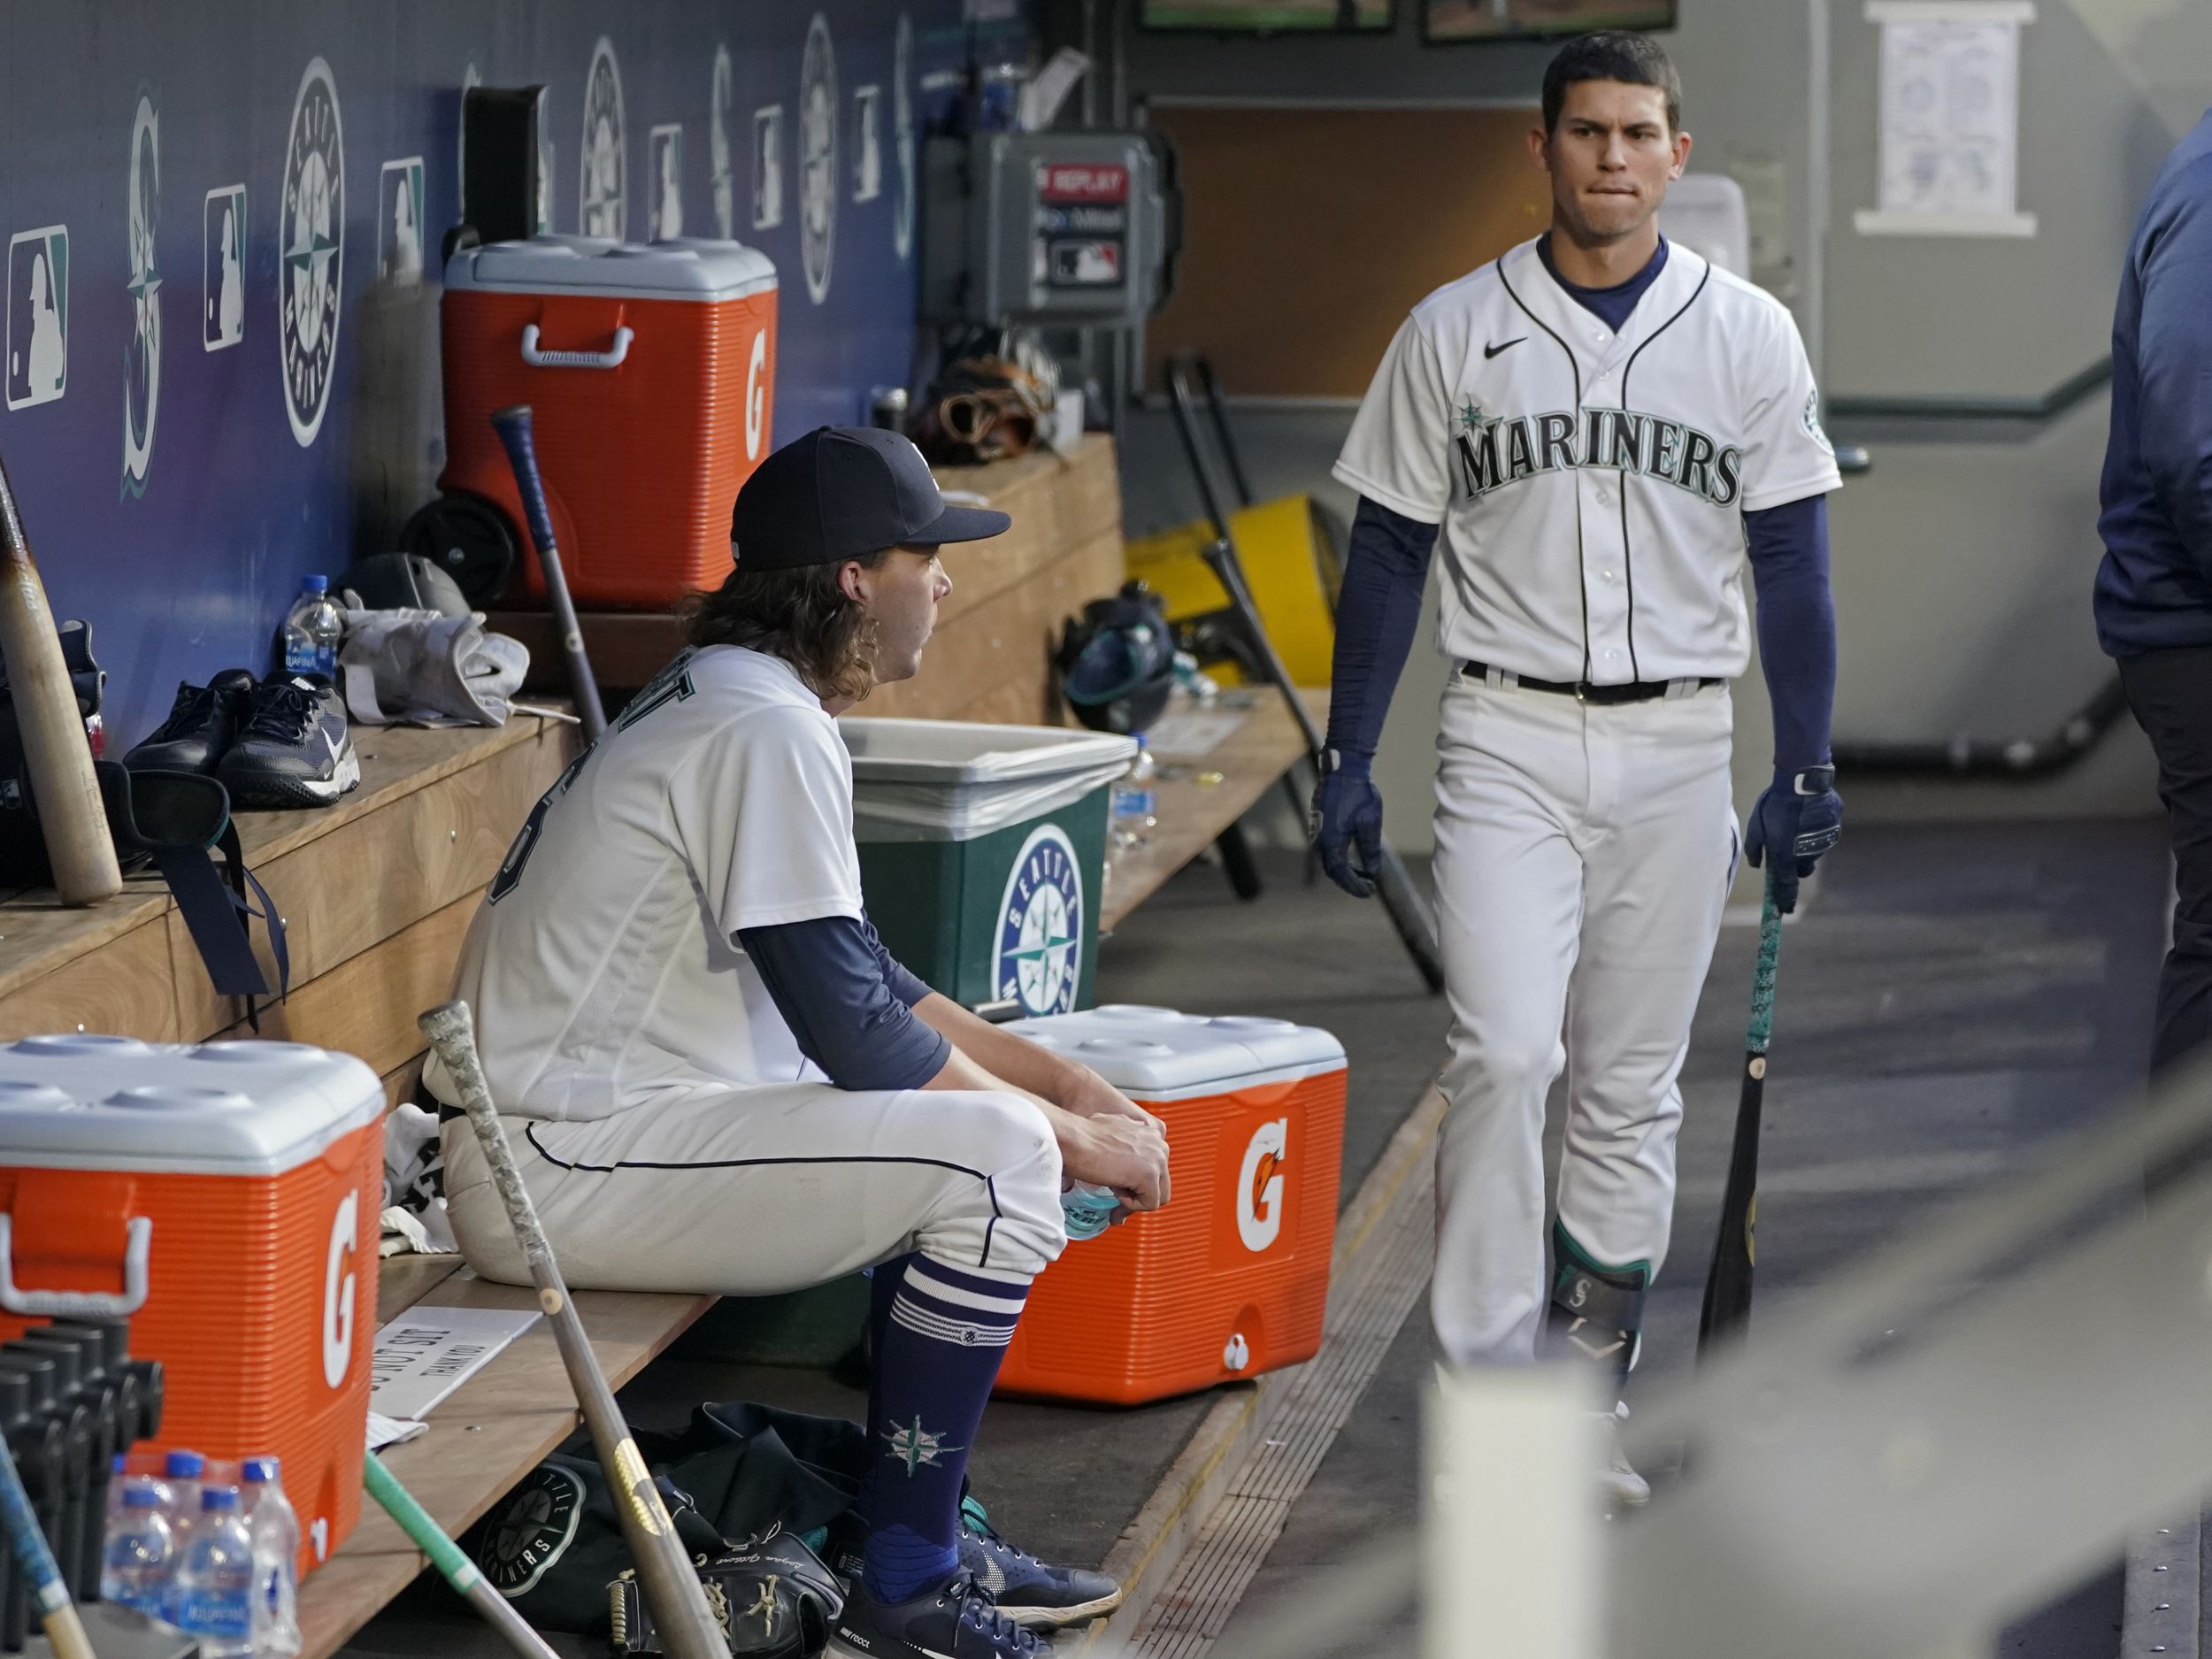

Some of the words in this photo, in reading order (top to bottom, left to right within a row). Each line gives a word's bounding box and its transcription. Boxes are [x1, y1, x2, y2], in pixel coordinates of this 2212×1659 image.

[1053, 168, 1120, 193] REPLAY
[745, 327, 765, 462] G
[1453, 405, 1744, 509] MARINERS
[1008, 847, 1078, 930] SEATTLE
[1235, 1118, 1288, 1253] G
[322, 1187, 358, 1389] G
[387, 1327, 451, 1347] SIT
[443, 1344, 487, 1356] YOU
[372, 1347, 426, 1373] NOT
[419, 1356, 474, 1378] THANK
[534, 1472, 573, 1514] TTLE
[849, 1632, 871, 1649] react
